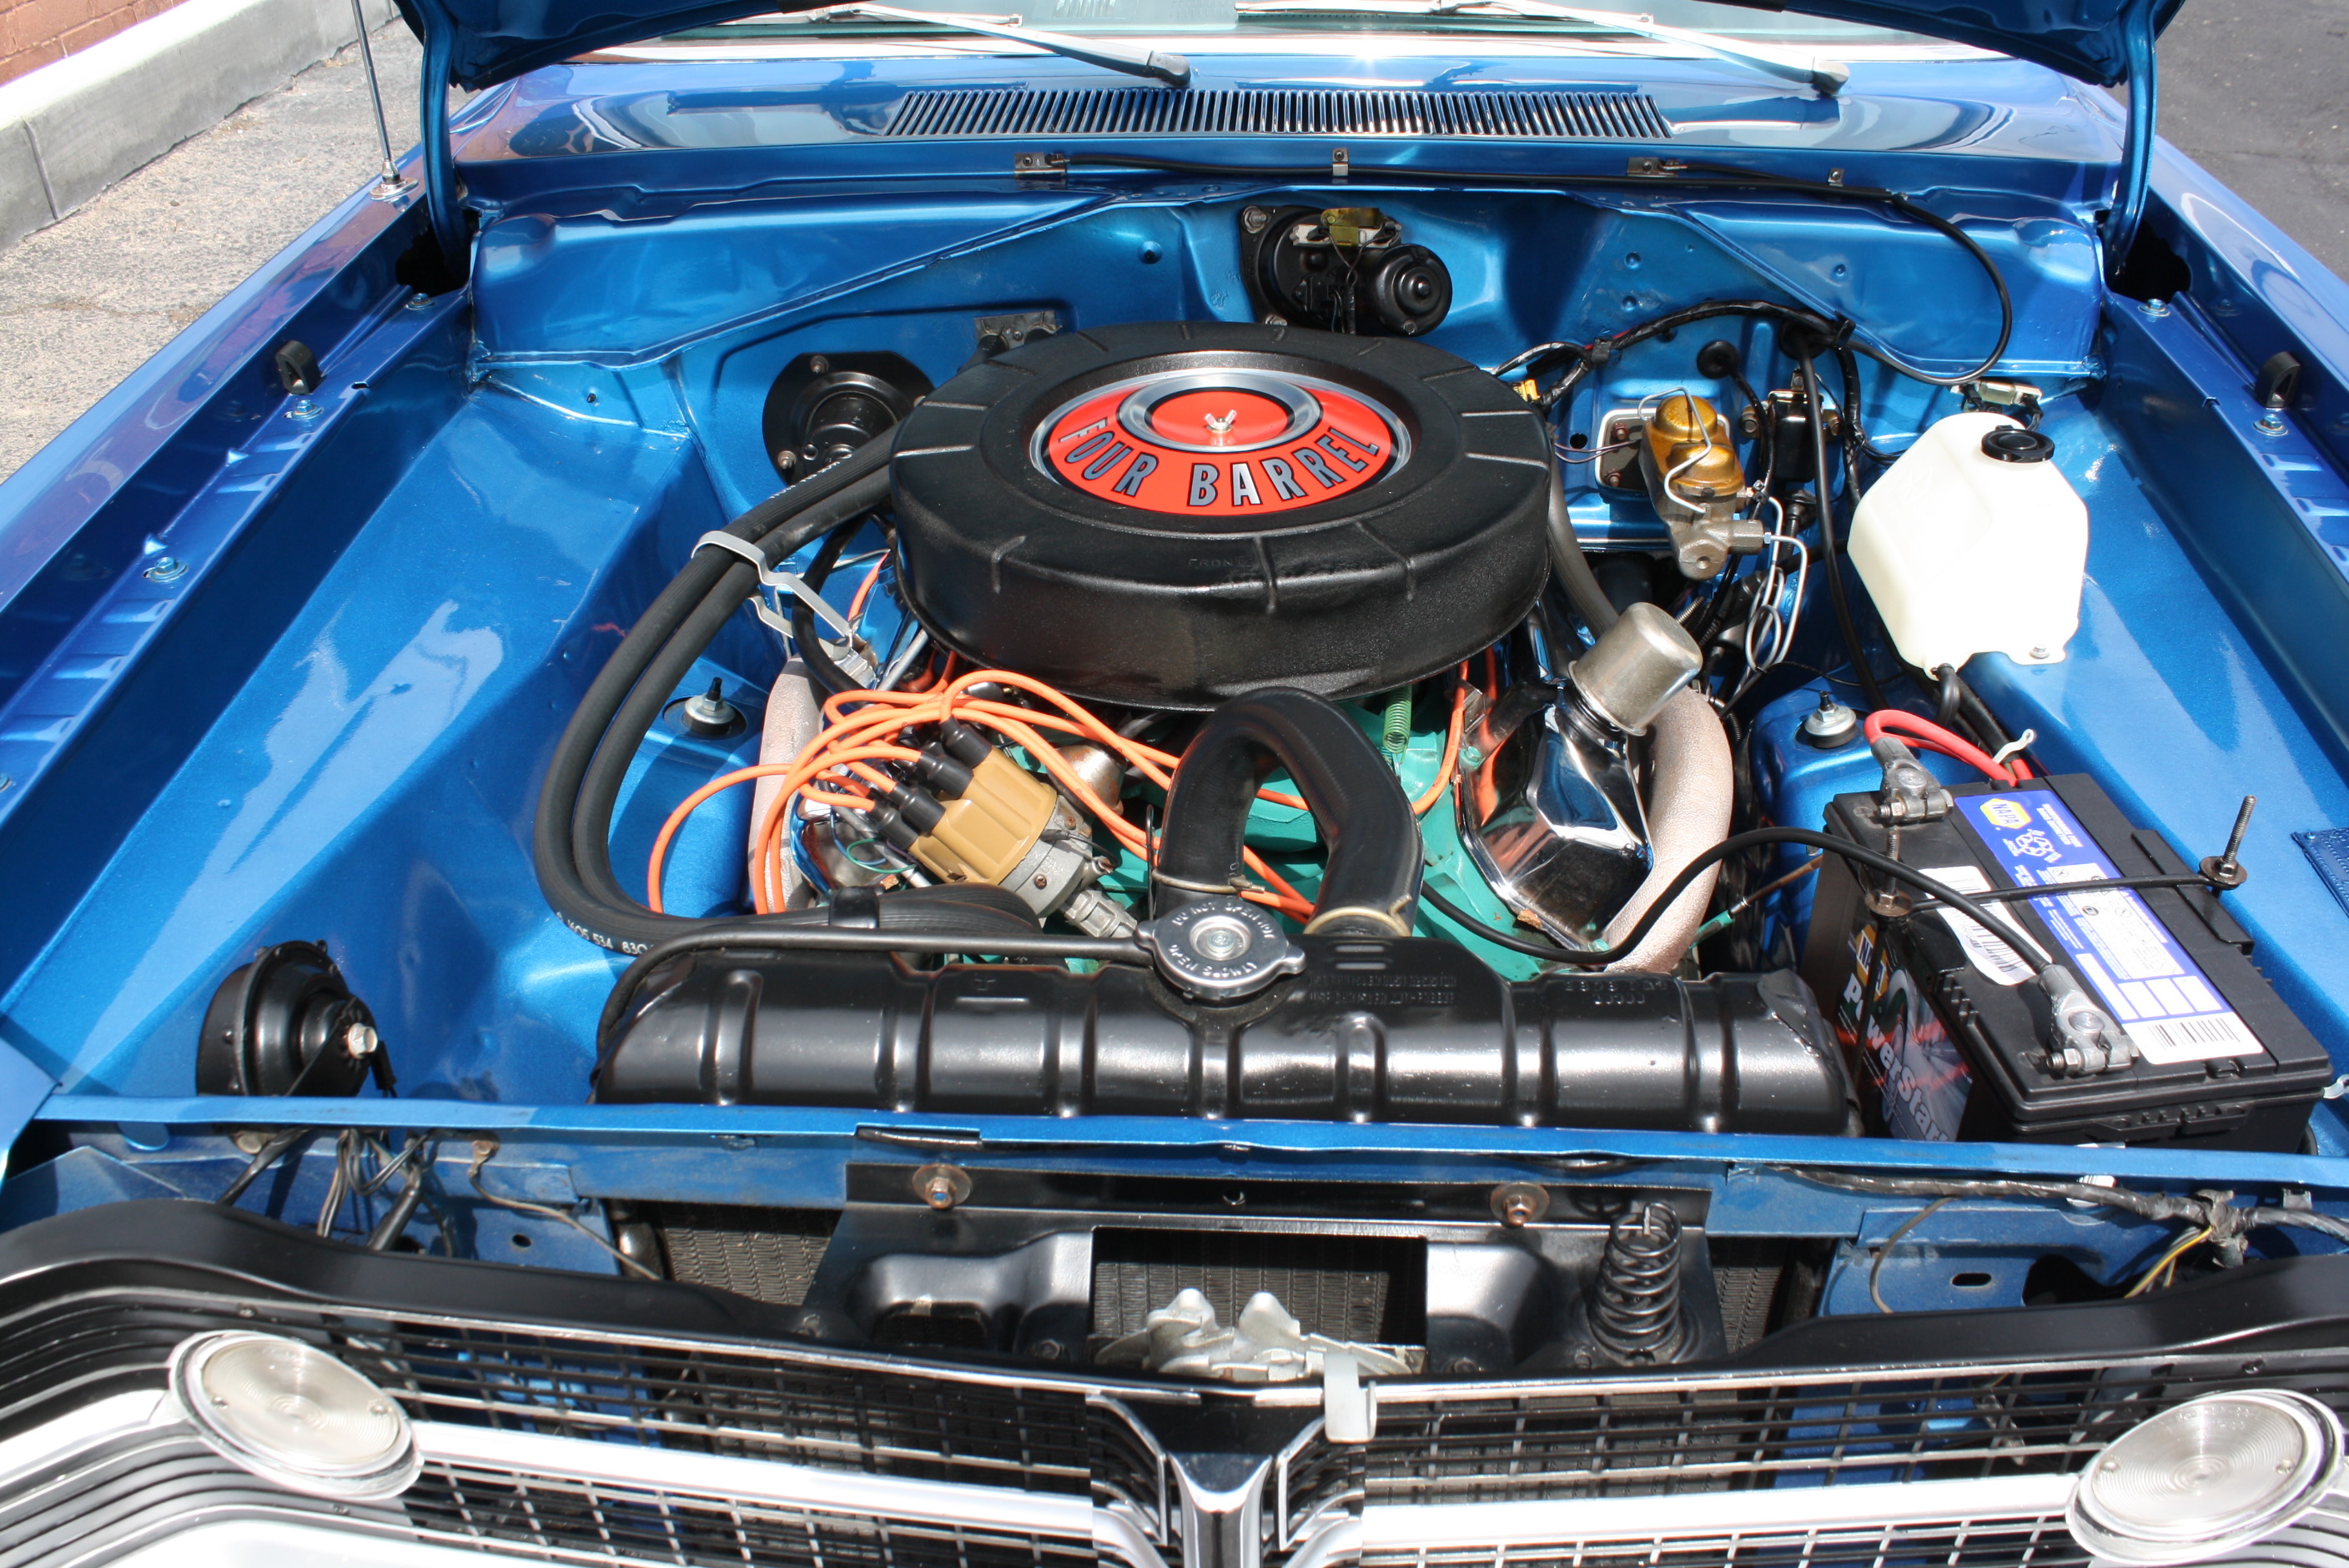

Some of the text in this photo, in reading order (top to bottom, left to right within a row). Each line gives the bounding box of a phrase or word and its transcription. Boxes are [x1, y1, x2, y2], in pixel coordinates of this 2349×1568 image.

[1059, 418, 1381, 508] FOUR BARREL
[1991, 803, 2020, 825] NAPA
